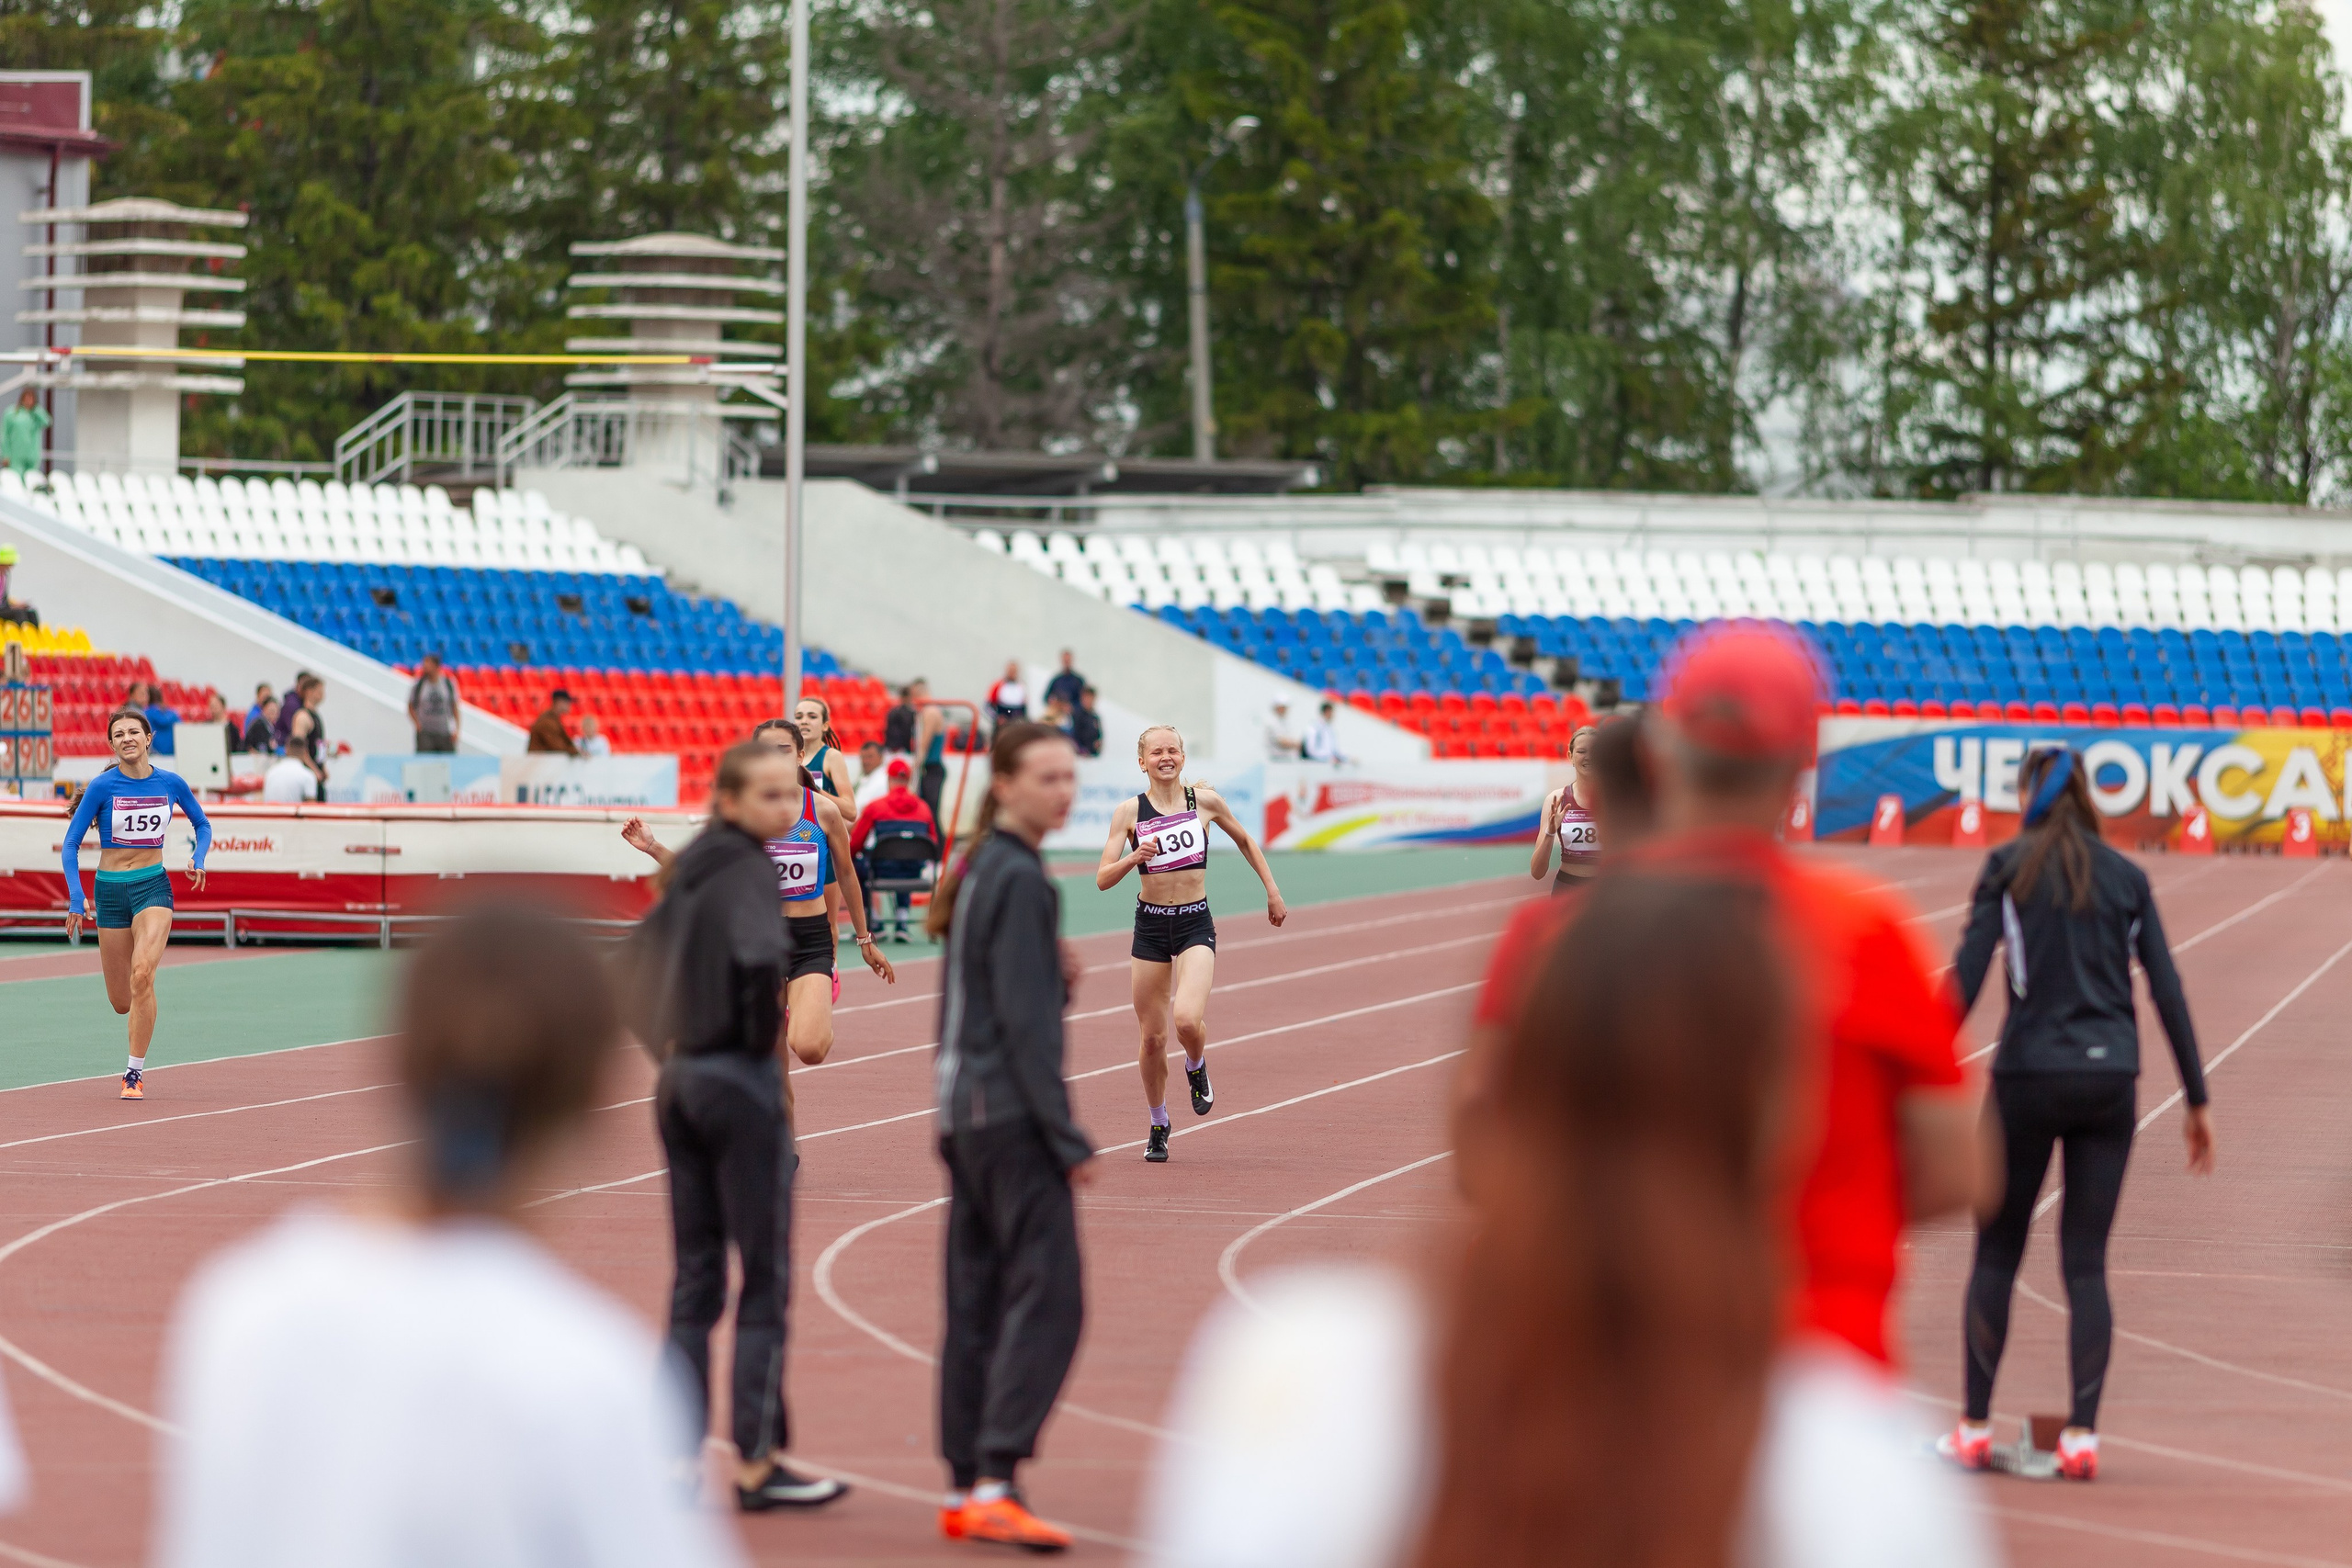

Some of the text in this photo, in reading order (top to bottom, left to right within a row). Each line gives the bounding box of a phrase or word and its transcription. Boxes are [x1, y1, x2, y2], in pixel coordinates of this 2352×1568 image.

[1933, 737, 2352, 820] ЧЕОКСА
[124, 815, 161, 831] 159
[1879, 800, 1898, 830] 7
[1960, 804, 1980, 834] 6
[2188, 811, 2207, 840] 4
[2291, 812, 2311, 841] 3
[1156, 829, 1194, 856] 130
[1571, 827, 1596, 843] 28
[1144, 901, 1206, 916] NIKE PRO
